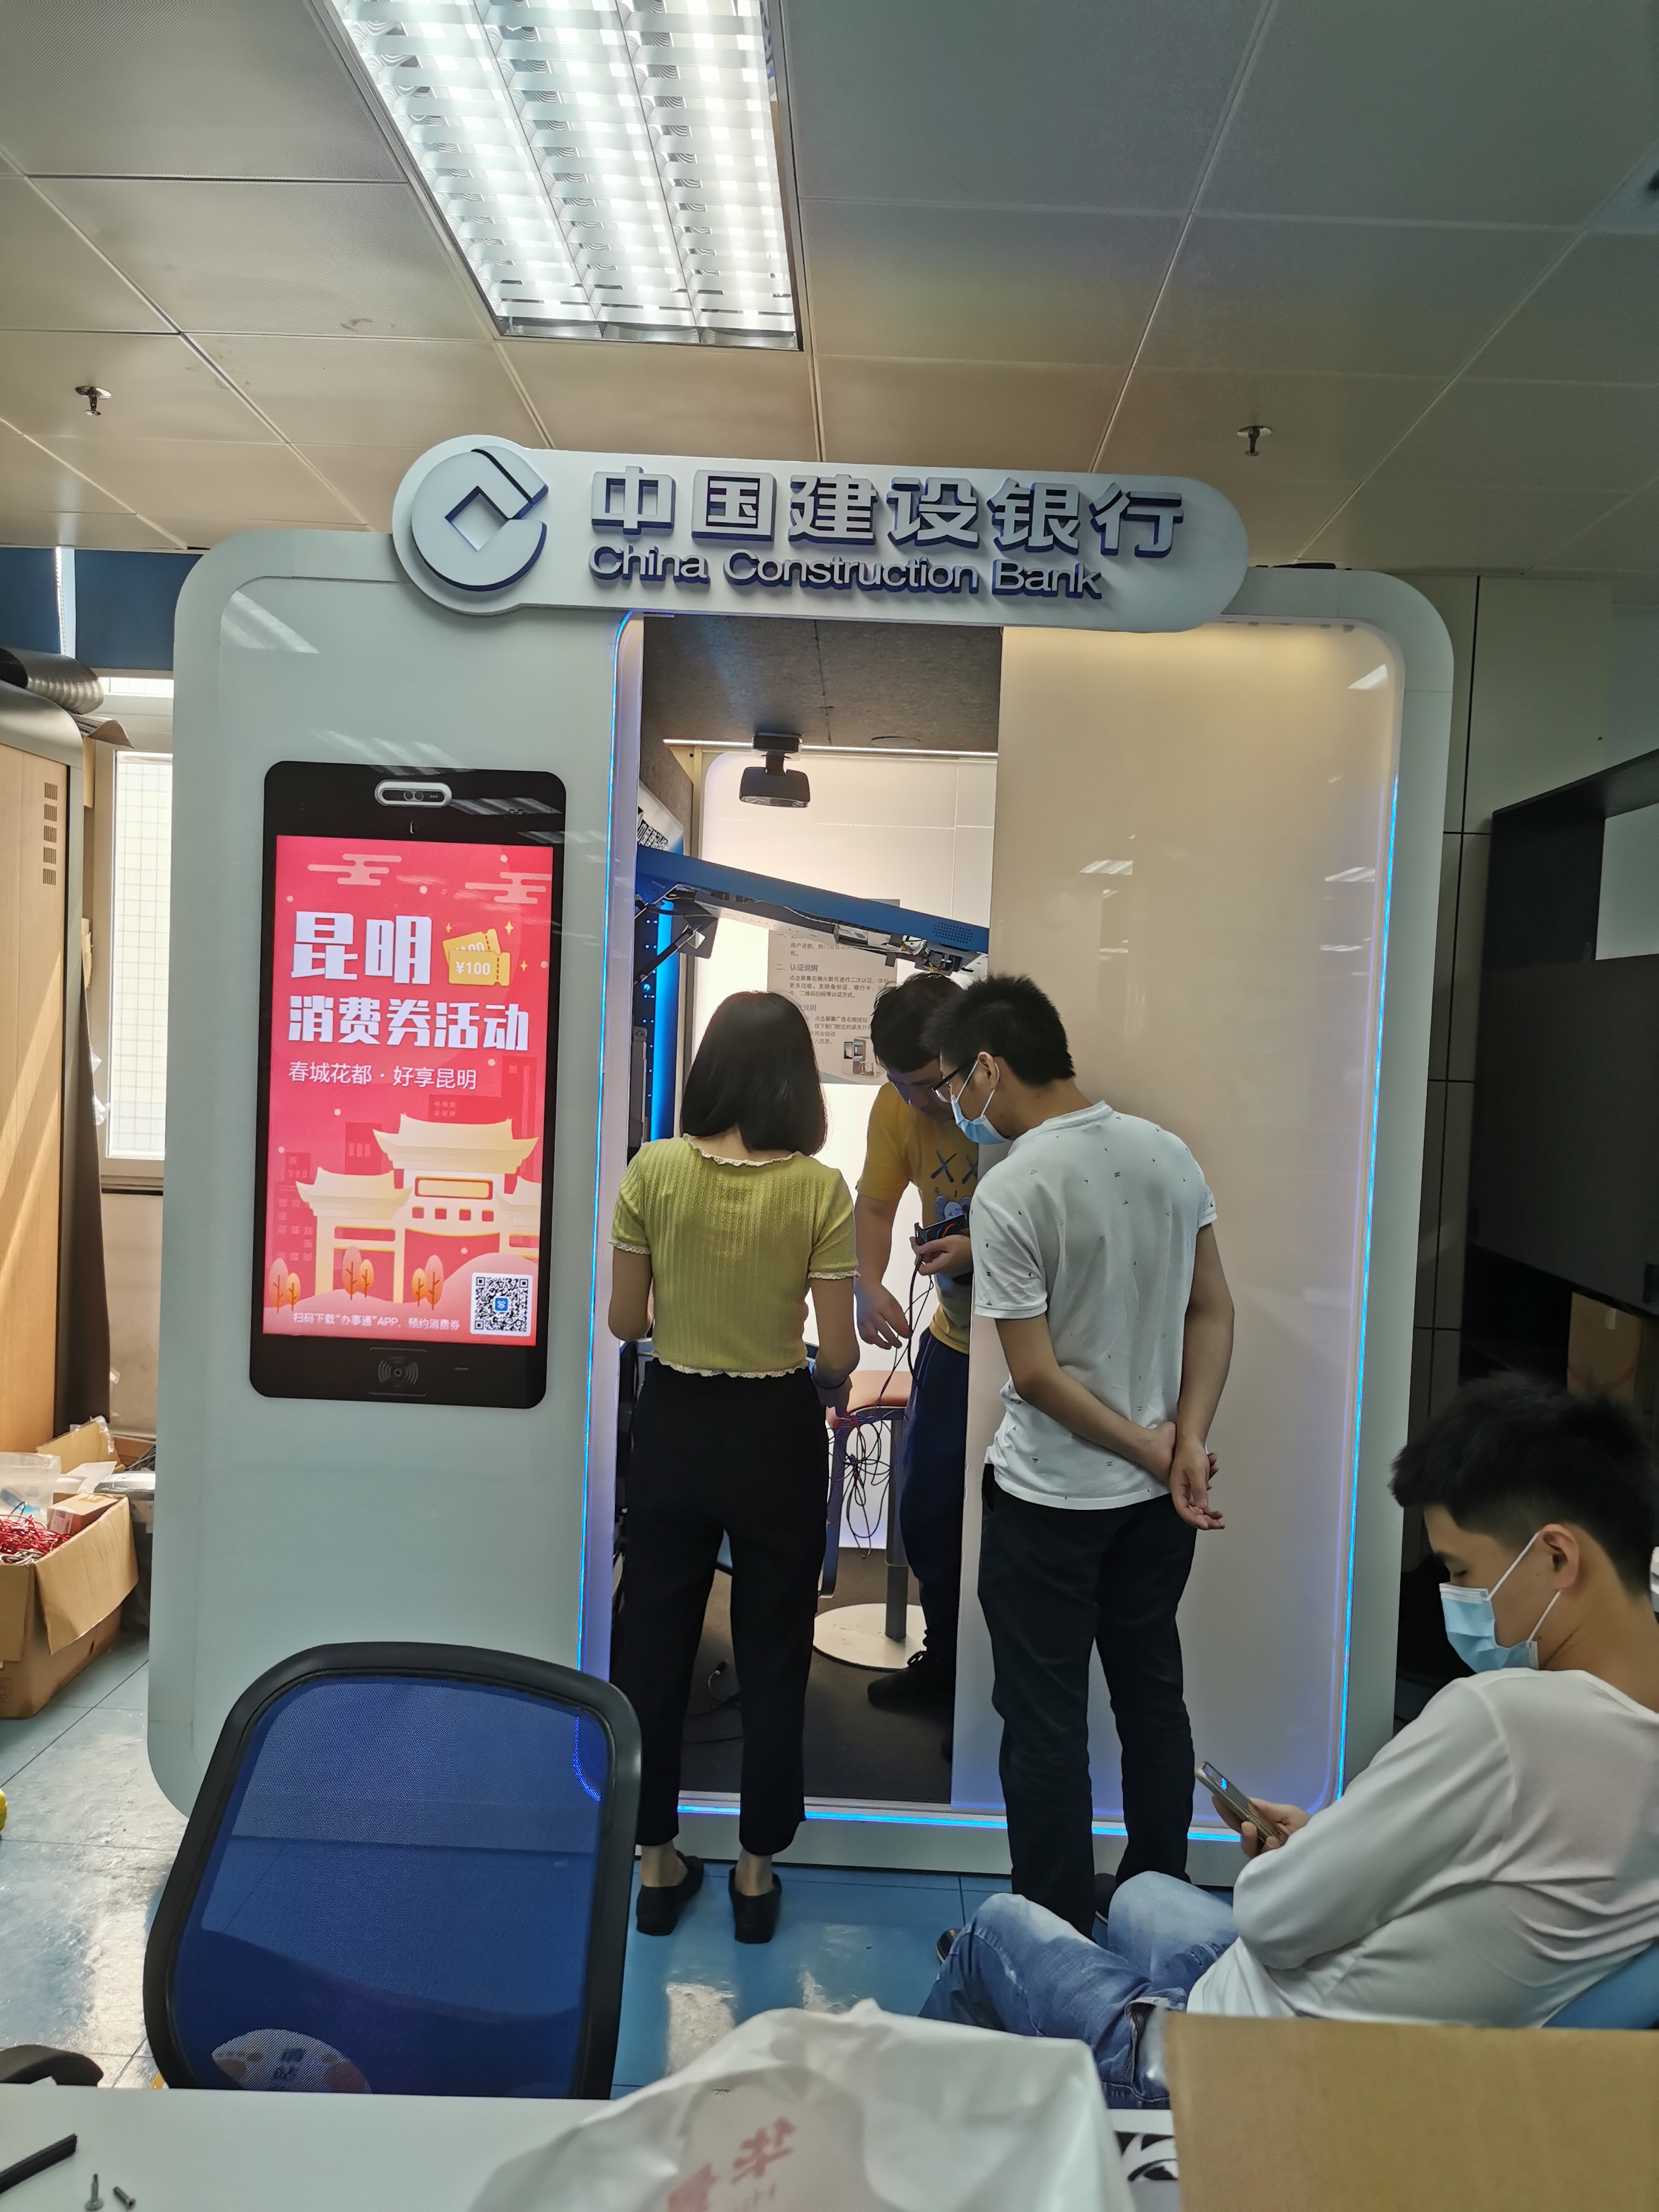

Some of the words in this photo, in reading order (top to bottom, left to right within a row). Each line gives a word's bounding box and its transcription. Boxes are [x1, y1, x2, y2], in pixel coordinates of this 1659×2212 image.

[591, 466, 1184, 558] 中国建设银行
[589, 544, 710, 585] China
[723, 549, 979, 594] Construction
[992, 559, 1102, 599] Bank
[291, 911, 432, 985] 昆明
[455, 961, 491, 976] ¥100
[288, 995, 529, 1051] 消费券活动
